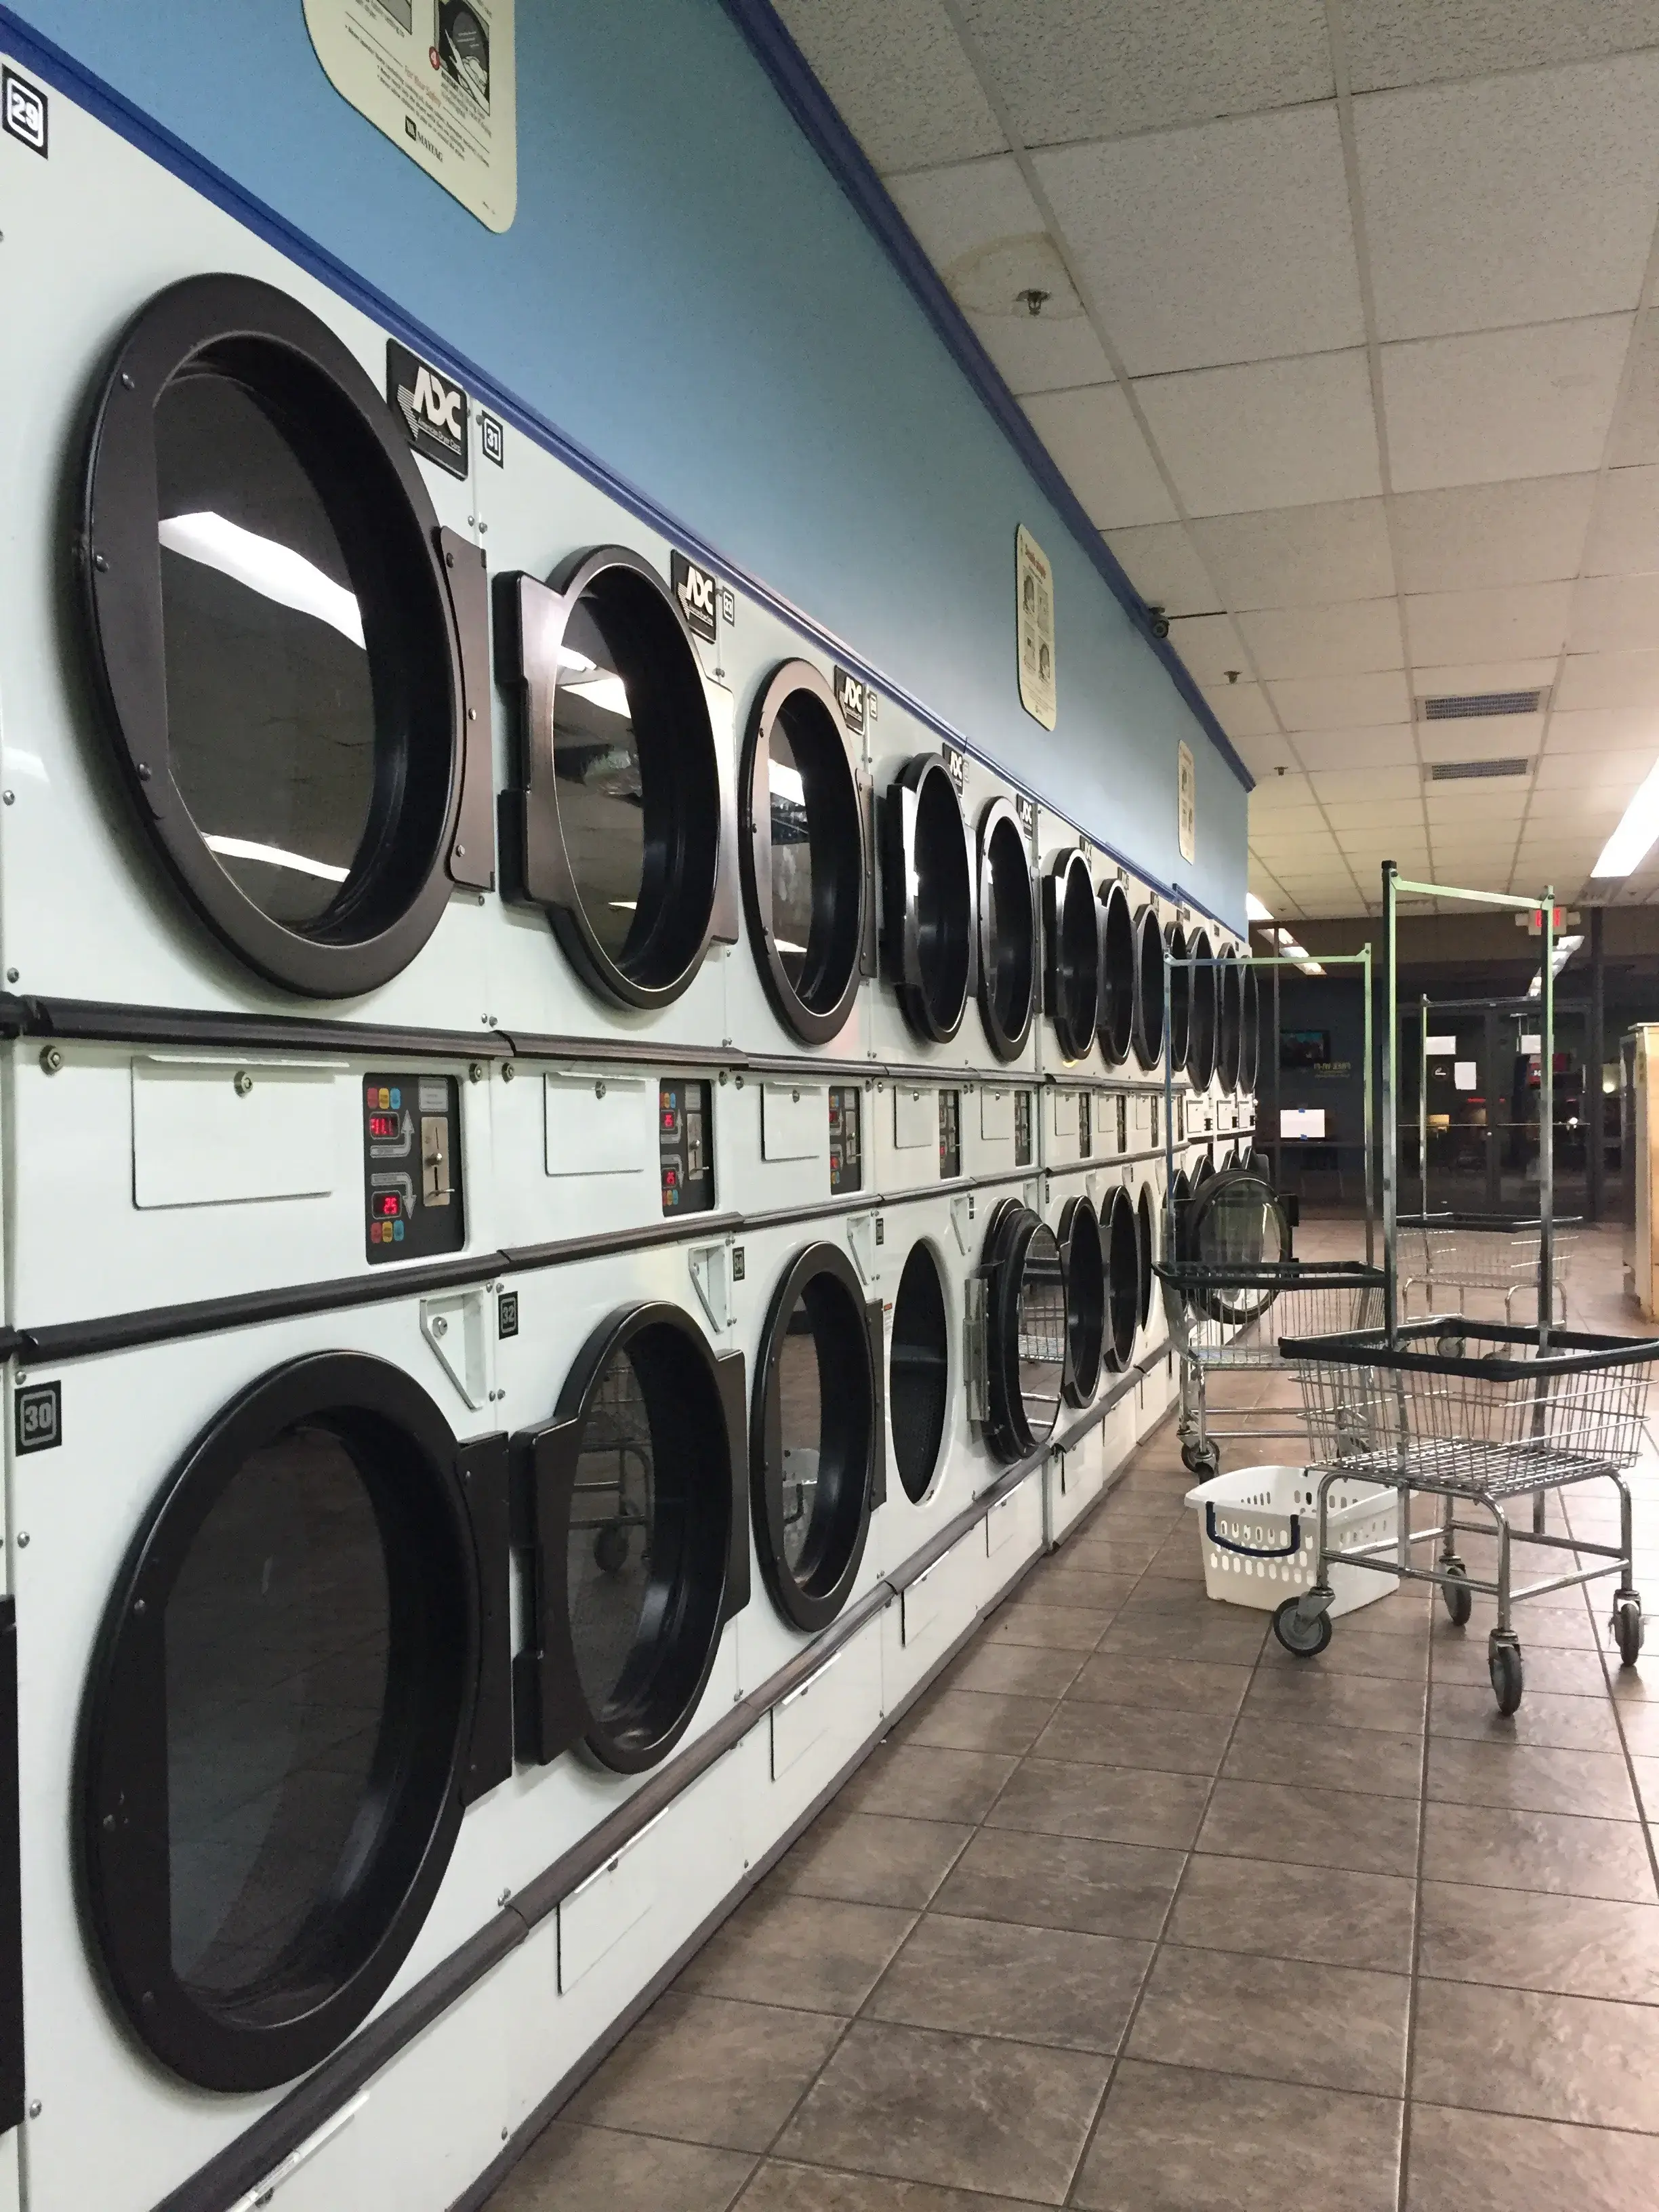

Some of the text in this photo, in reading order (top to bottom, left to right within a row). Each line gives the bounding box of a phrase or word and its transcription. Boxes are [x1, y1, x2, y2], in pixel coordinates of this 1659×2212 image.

[12, 92, 38, 131] 29
[416, 131, 443, 163] MAYTAG
[413, 366, 461, 441] ADC
[487, 428, 498, 451] 31
[686, 566, 713, 616] ADC
[844, 676, 861, 714] ADC
[504, 1305, 514, 1324] 32
[26, 1403, 52, 1432] 30
